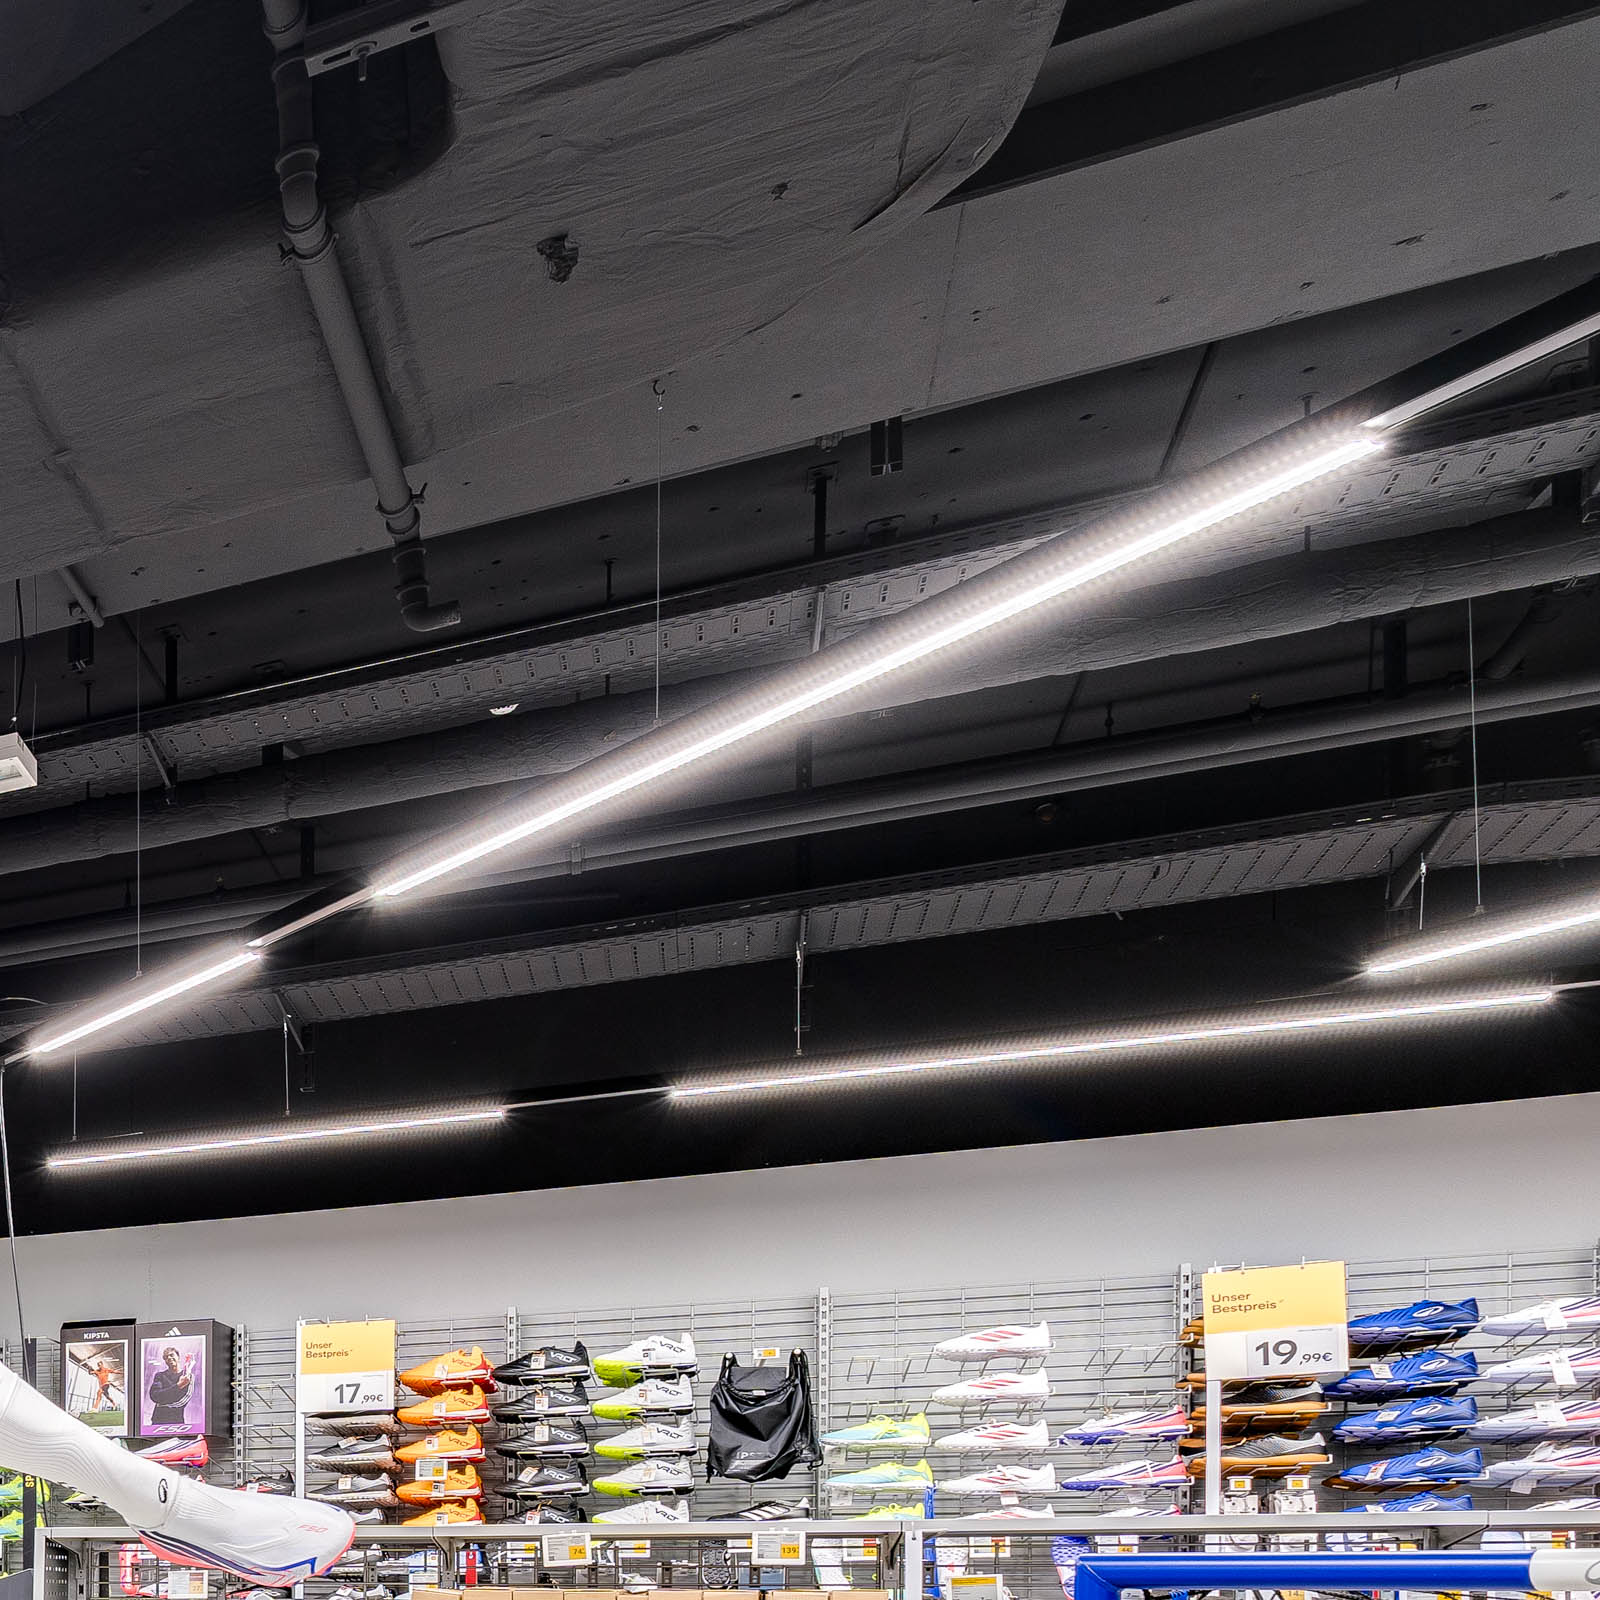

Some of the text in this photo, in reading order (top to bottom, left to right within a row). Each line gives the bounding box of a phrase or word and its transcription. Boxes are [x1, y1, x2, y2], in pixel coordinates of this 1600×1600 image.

[1211, 1293, 1251, 1303] Unser
[1212, 1301, 1277, 1314] Bestpreis
[83, 1332, 110, 1340] KIPSTA
[305, 1341, 333, 1351] Unser
[305, 1349, 349, 1360] Bestpreis
[1255, 1340, 1333, 1366] 19,99€
[334, 1383, 384, 1405] 17,99€
[152, 1424, 193, 1434] F50
